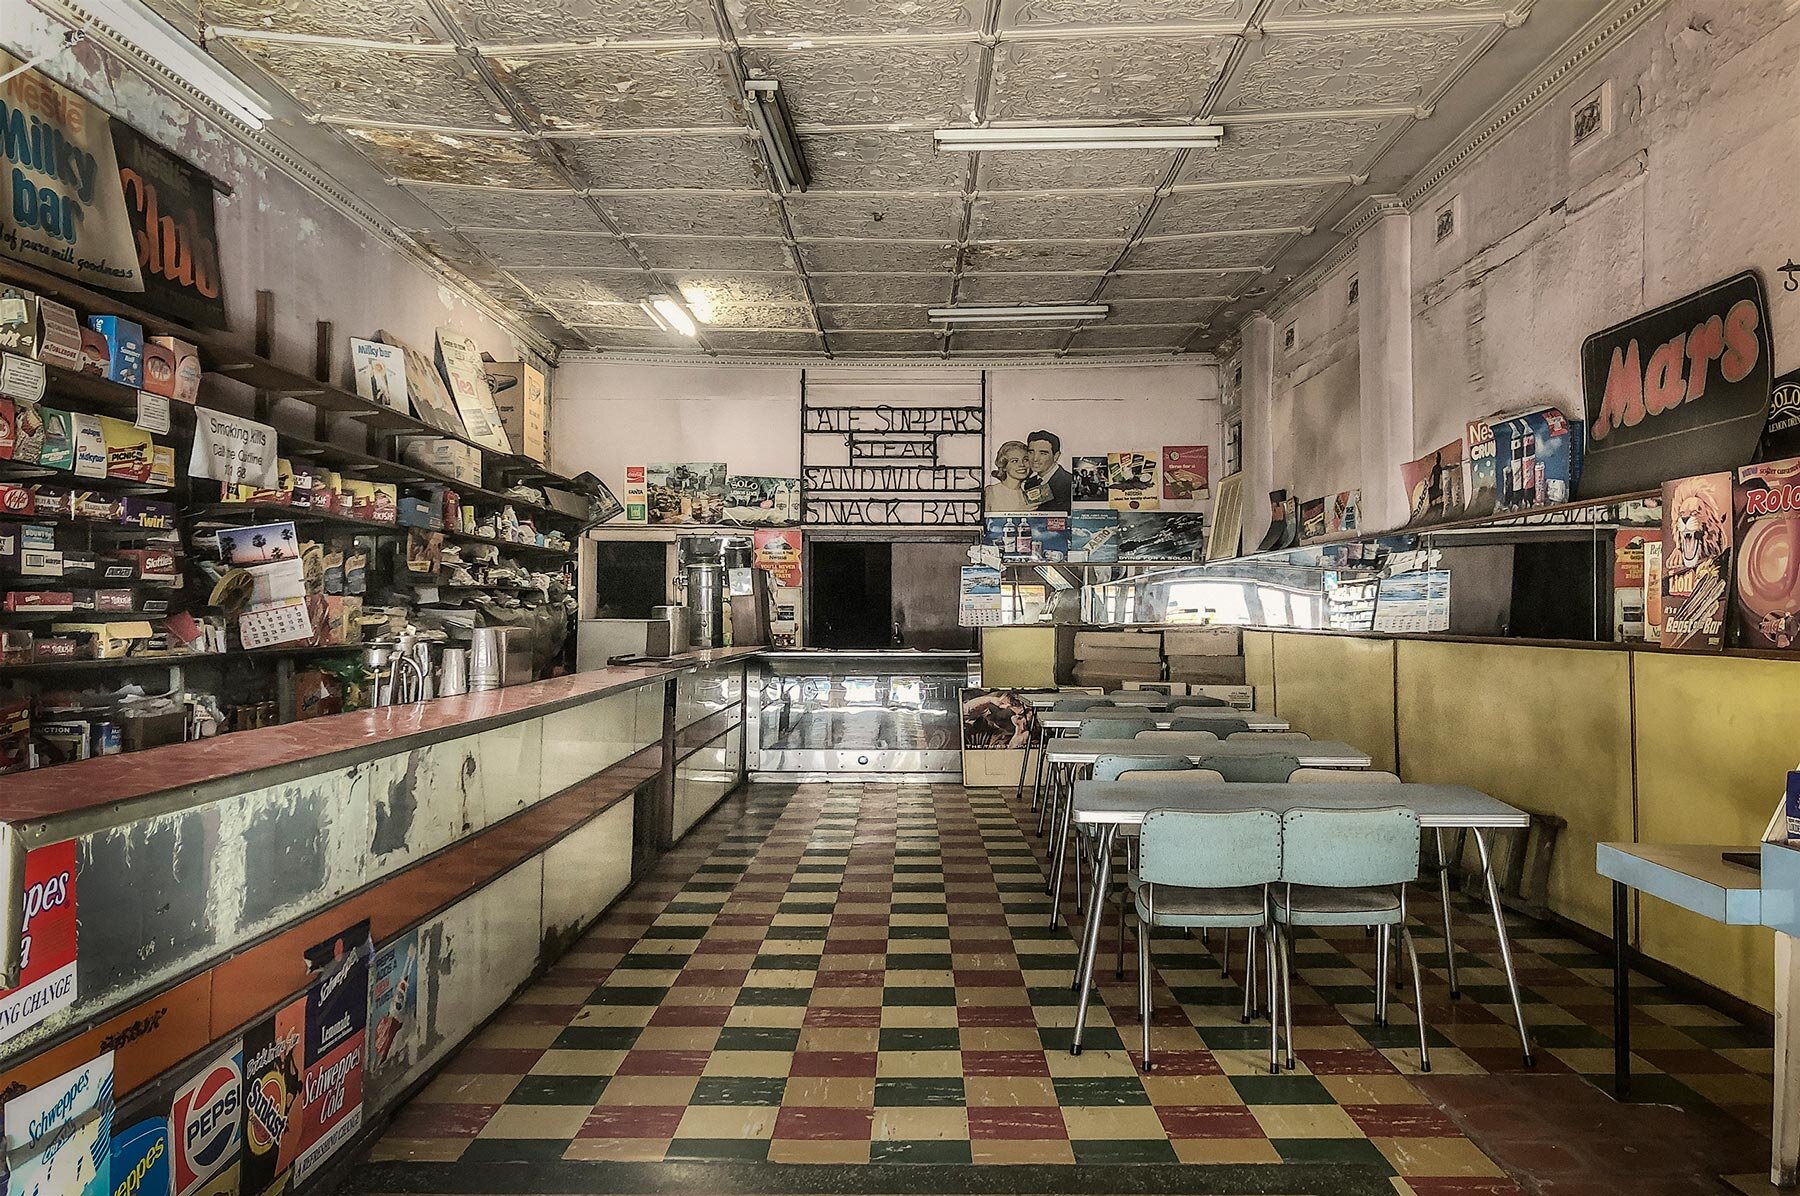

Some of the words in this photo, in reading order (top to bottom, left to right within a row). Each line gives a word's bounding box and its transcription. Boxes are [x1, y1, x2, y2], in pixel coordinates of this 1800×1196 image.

[7, 76, 83, 134] Nestlé
[0, 103, 98, 206] Milky
[11, 167, 84, 245] bar
[50, 243, 76, 265] milk
[77, 257, 134, 280] goodness
[451, 372, 475, 396] Tea
[1591, 299, 1759, 441] Mars
[210, 417, 249, 445] Smoking
[250, 428, 266, 447] kills
[806, 408, 860, 431] LATE
[852, 442, 934, 458] STEAK
[731, 479, 759, 491] SOLO
[804, 468, 982, 491] SANDWICHES
[139, 512, 165, 528] Twirl
[806, 500, 900, 524] SNACK
[921, 501, 981, 524] BAR
[1668, 572, 1694, 593] Lion
[1665, 616, 1694, 634] Beast
[1703, 617, 1723, 635] Bar
[22, 974, 73, 1021] CHANGE
[321, 1011, 351, 1045] Lemonade
[302, 1044, 362, 1110] Schweppes
[29, 1069, 90, 1149] Schweppes
[187, 1083, 240, 1150] PEPSI
[246, 1078, 289, 1146] Sunkist
[320, 1086, 346, 1124] Cola
